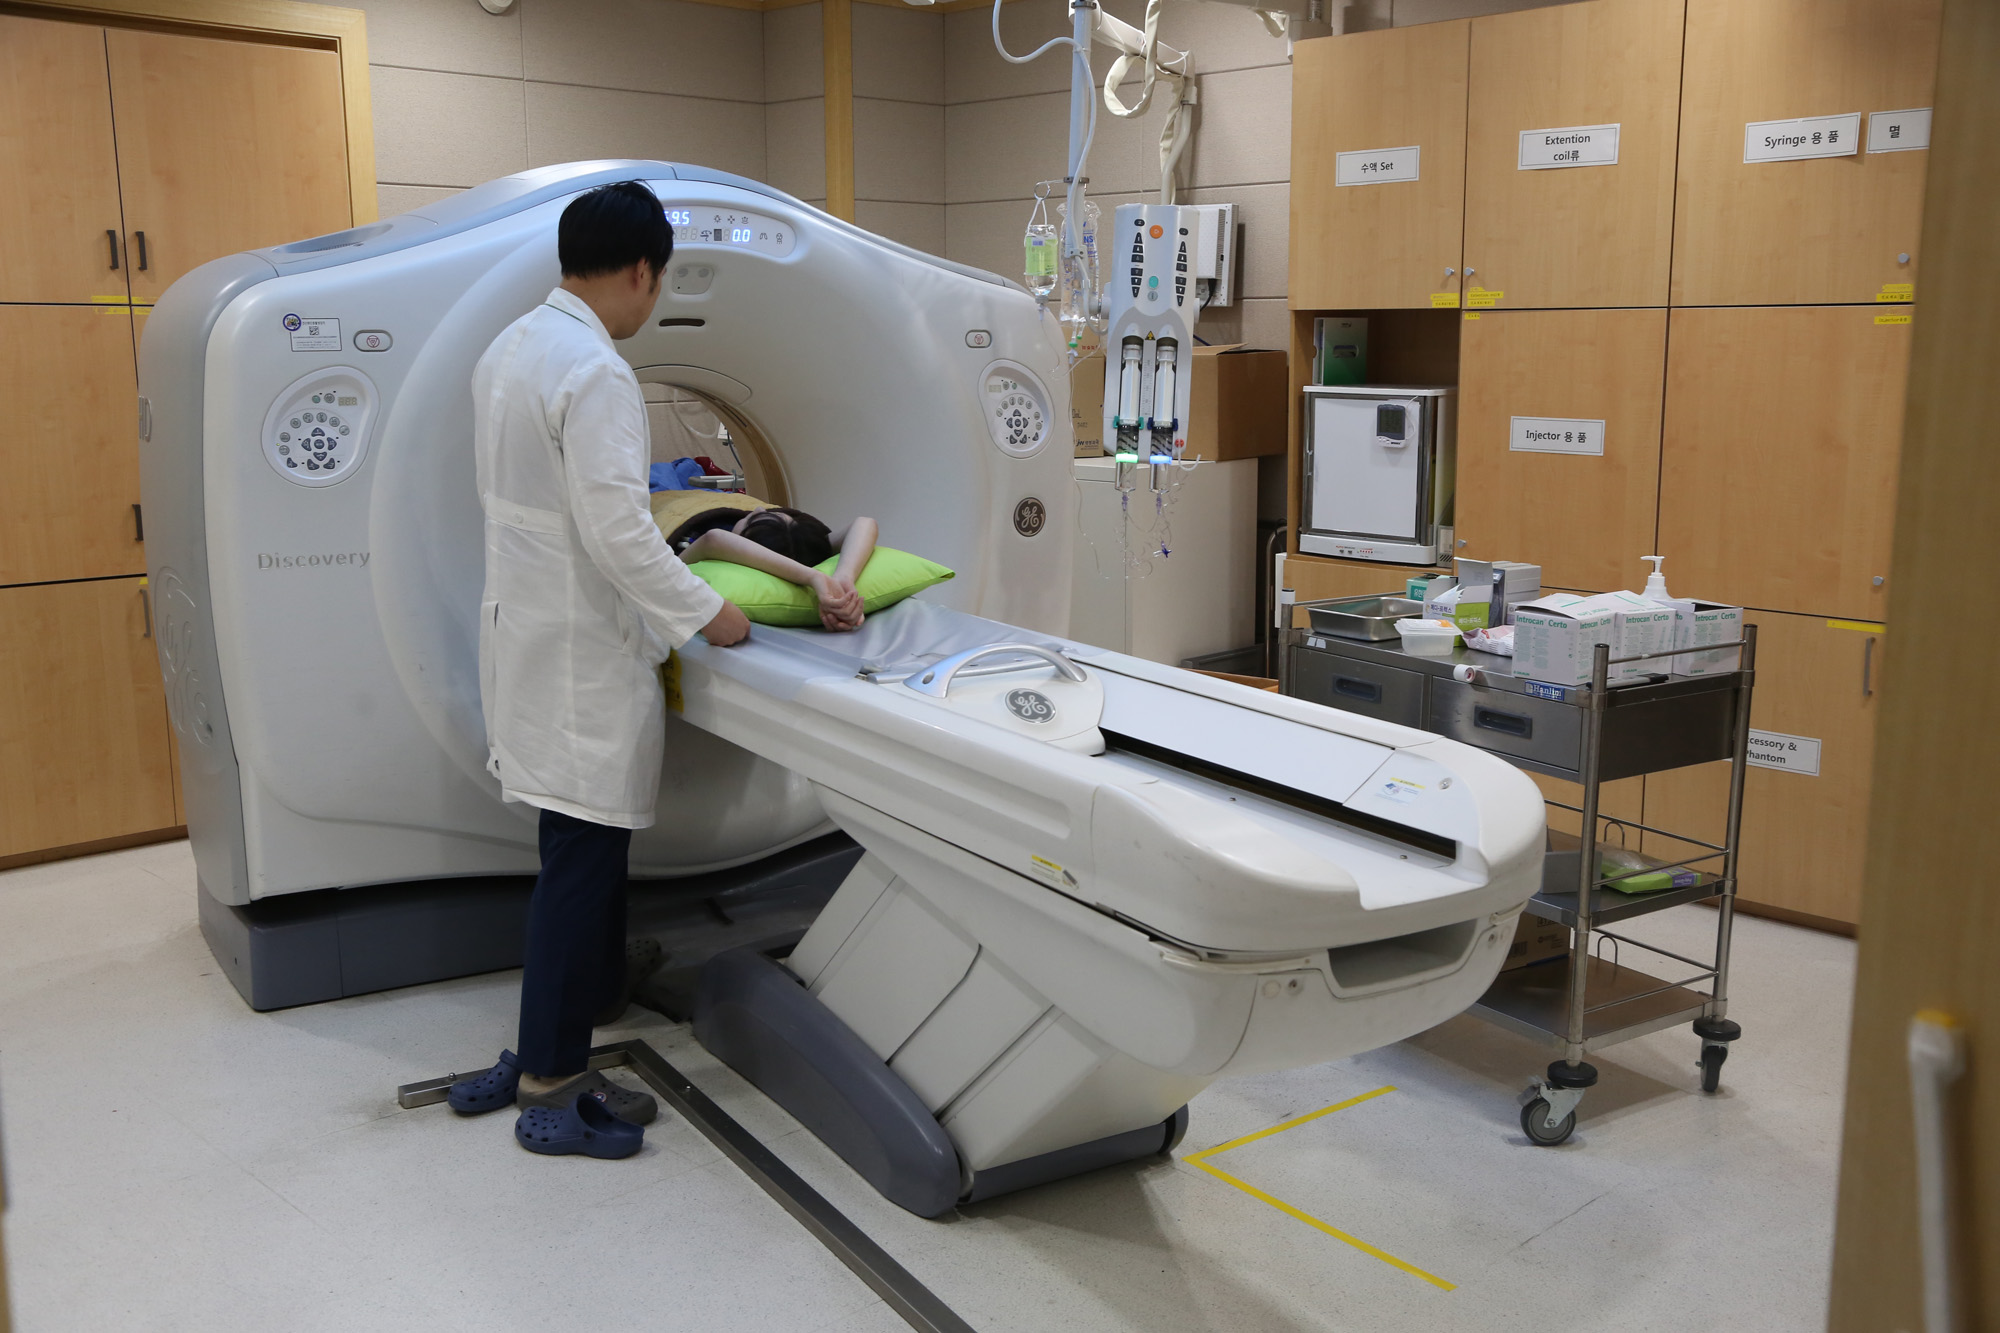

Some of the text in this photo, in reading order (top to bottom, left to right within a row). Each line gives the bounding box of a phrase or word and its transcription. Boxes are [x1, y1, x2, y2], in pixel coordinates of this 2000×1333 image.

[1889, 125, 1900, 138] 멸
[1545, 133, 1591, 146] Extention
[1764, 134, 1806, 149] Syringe
[1553, 150, 1580, 162] coil류
[1361, 161, 1394, 173] 수액 Set
[1525, 429, 1561, 443] Injector
[257, 551, 371, 570] Discovery
[1600, 617, 1611, 626] Certo
[1653, 613, 1669, 622] Certo
[1548, 619, 1568, 629] Certo
[1788, 742, 1797, 751] &
